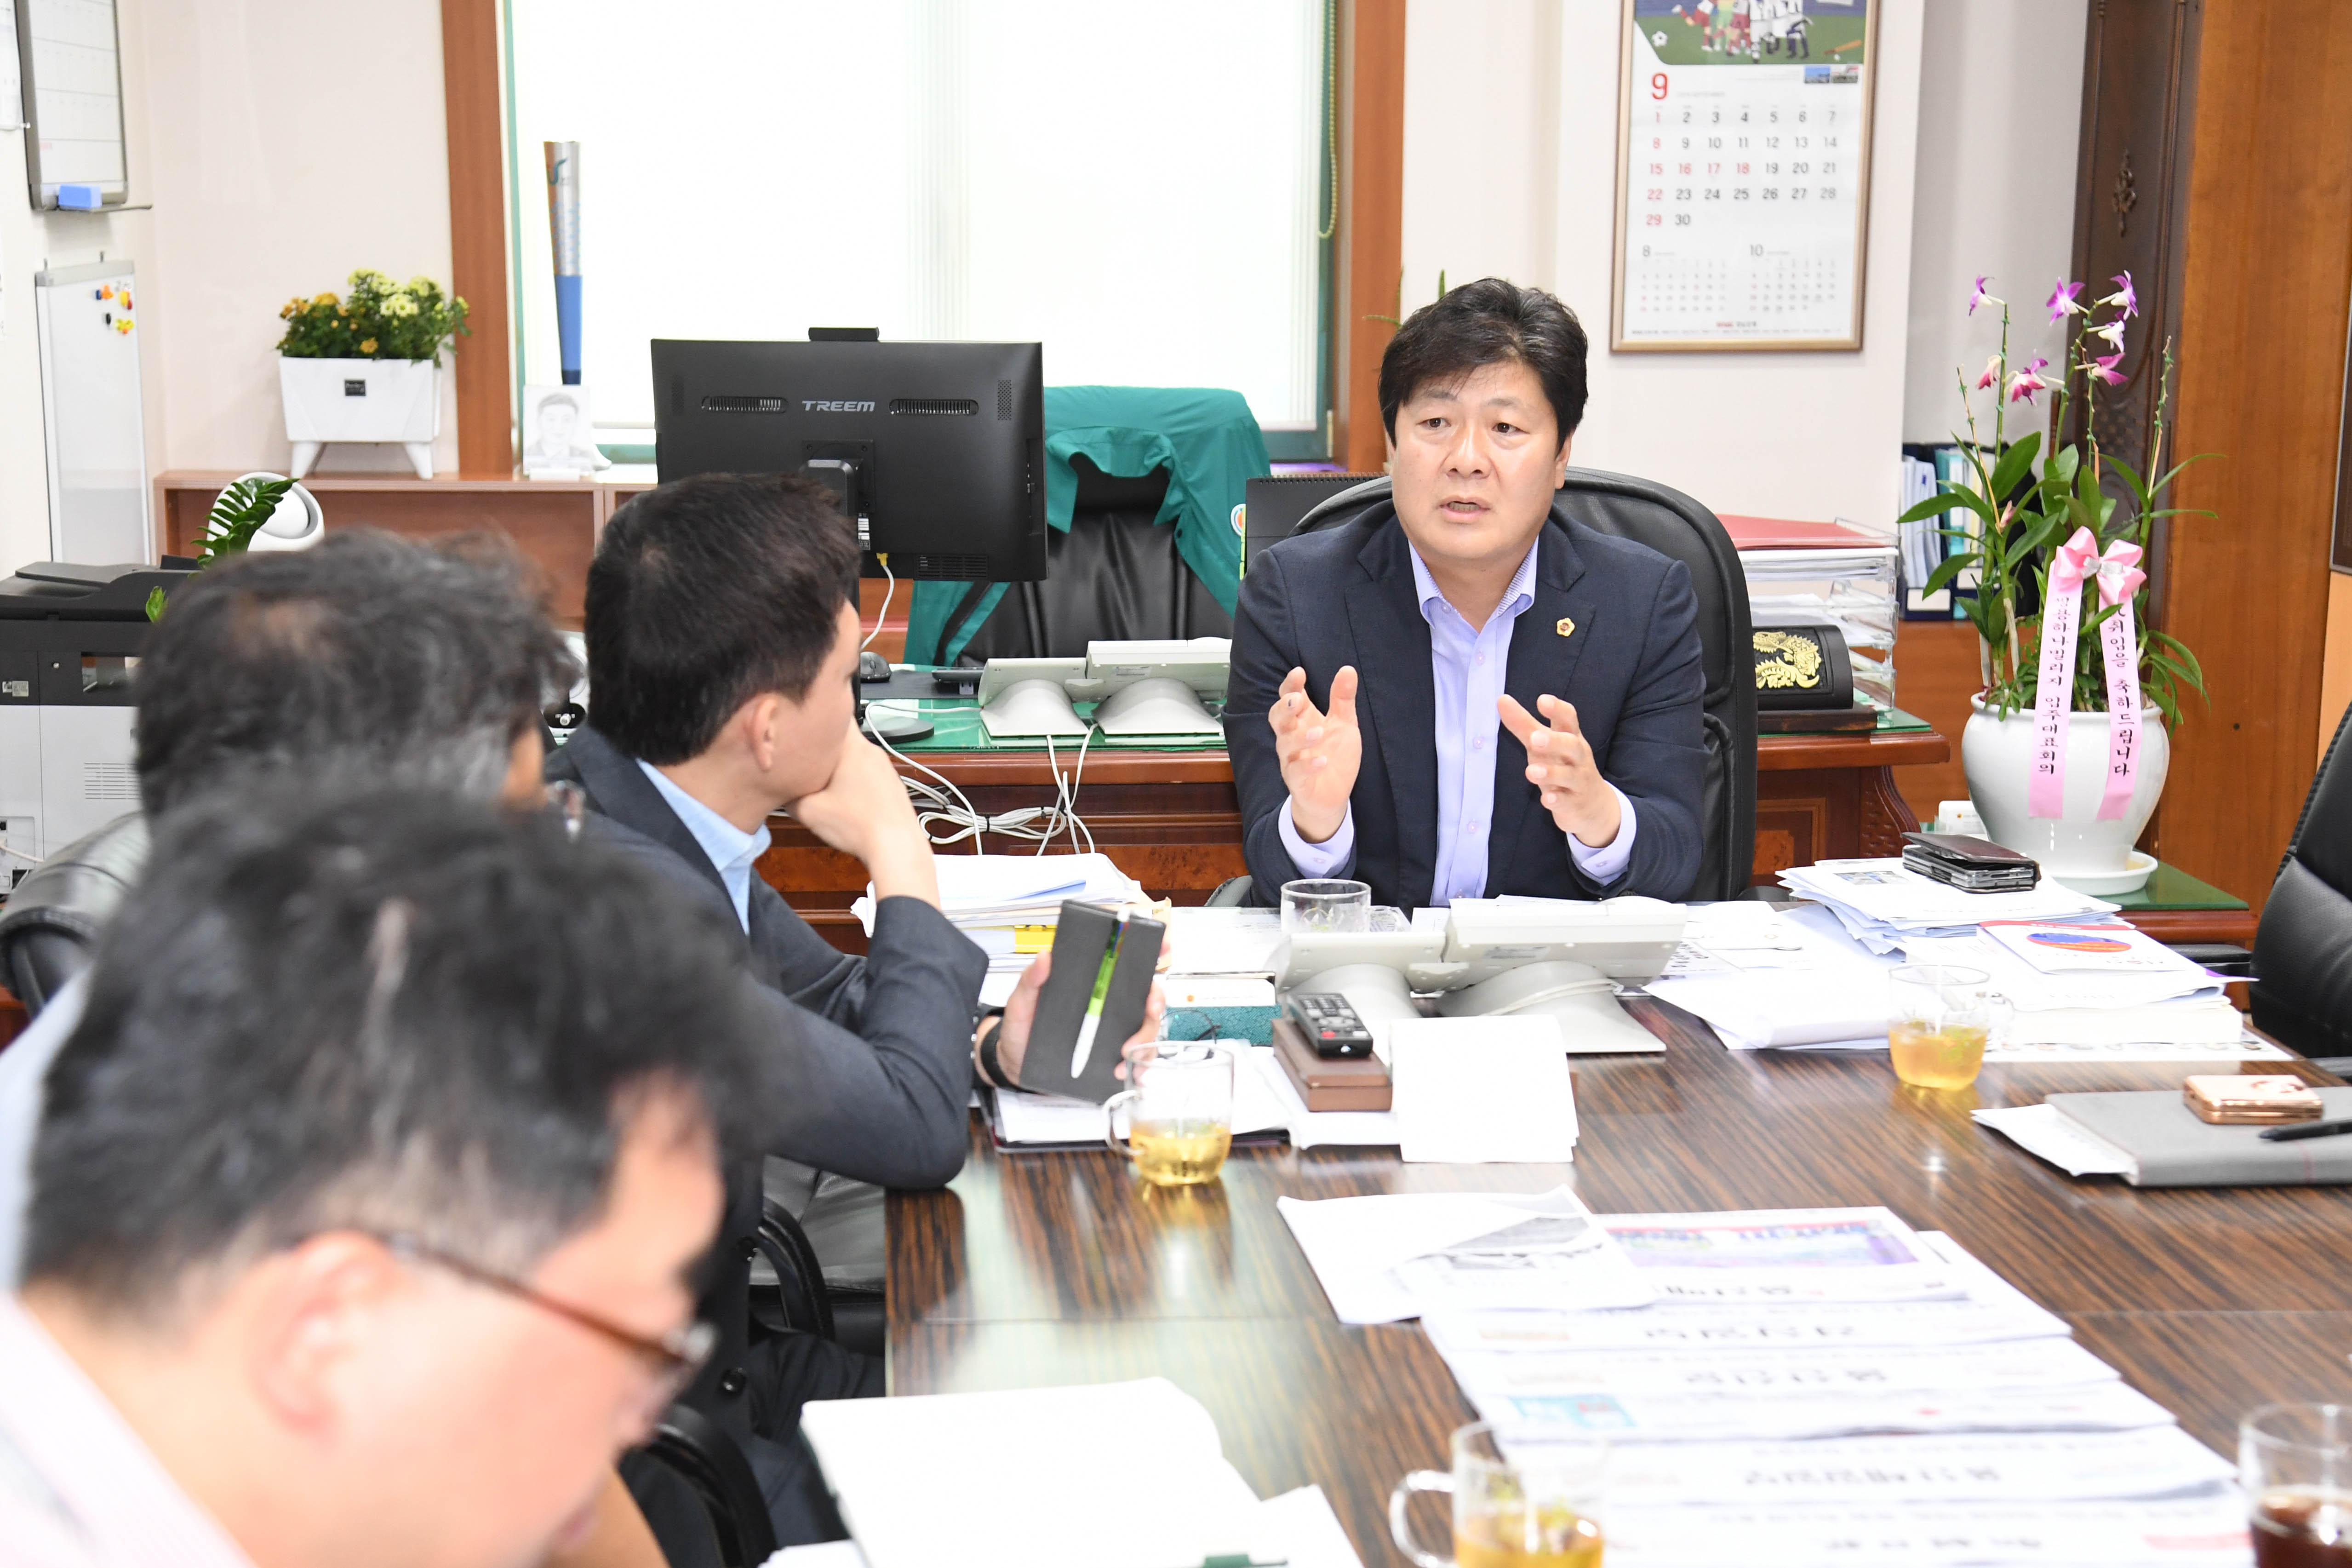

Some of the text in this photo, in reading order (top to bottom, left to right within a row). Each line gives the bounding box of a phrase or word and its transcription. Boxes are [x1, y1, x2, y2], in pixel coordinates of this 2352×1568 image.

[1652, 73, 1668, 100] 9
[1655, 110, 1837, 124] 1 2 3 4 5 6 7
[1653, 137, 1837, 149] 8 9 10 11 12 13 14
[1650, 162, 1836, 175] 15 16 17 18 19 20 21
[1647, 187, 1837, 201] 22 23 24 25 26 27 28
[1646, 214, 1691, 226] 29 30
[1642, 245, 1651, 258] 8
[1750, 244, 1764, 257] 10
[802, 400, 876, 412] TREEM
[2108, 620, 2129, 668] 취임을
[2112, 678, 2135, 777] 축하드립니다
[2038, 696, 2061, 775] 입주대표회의
